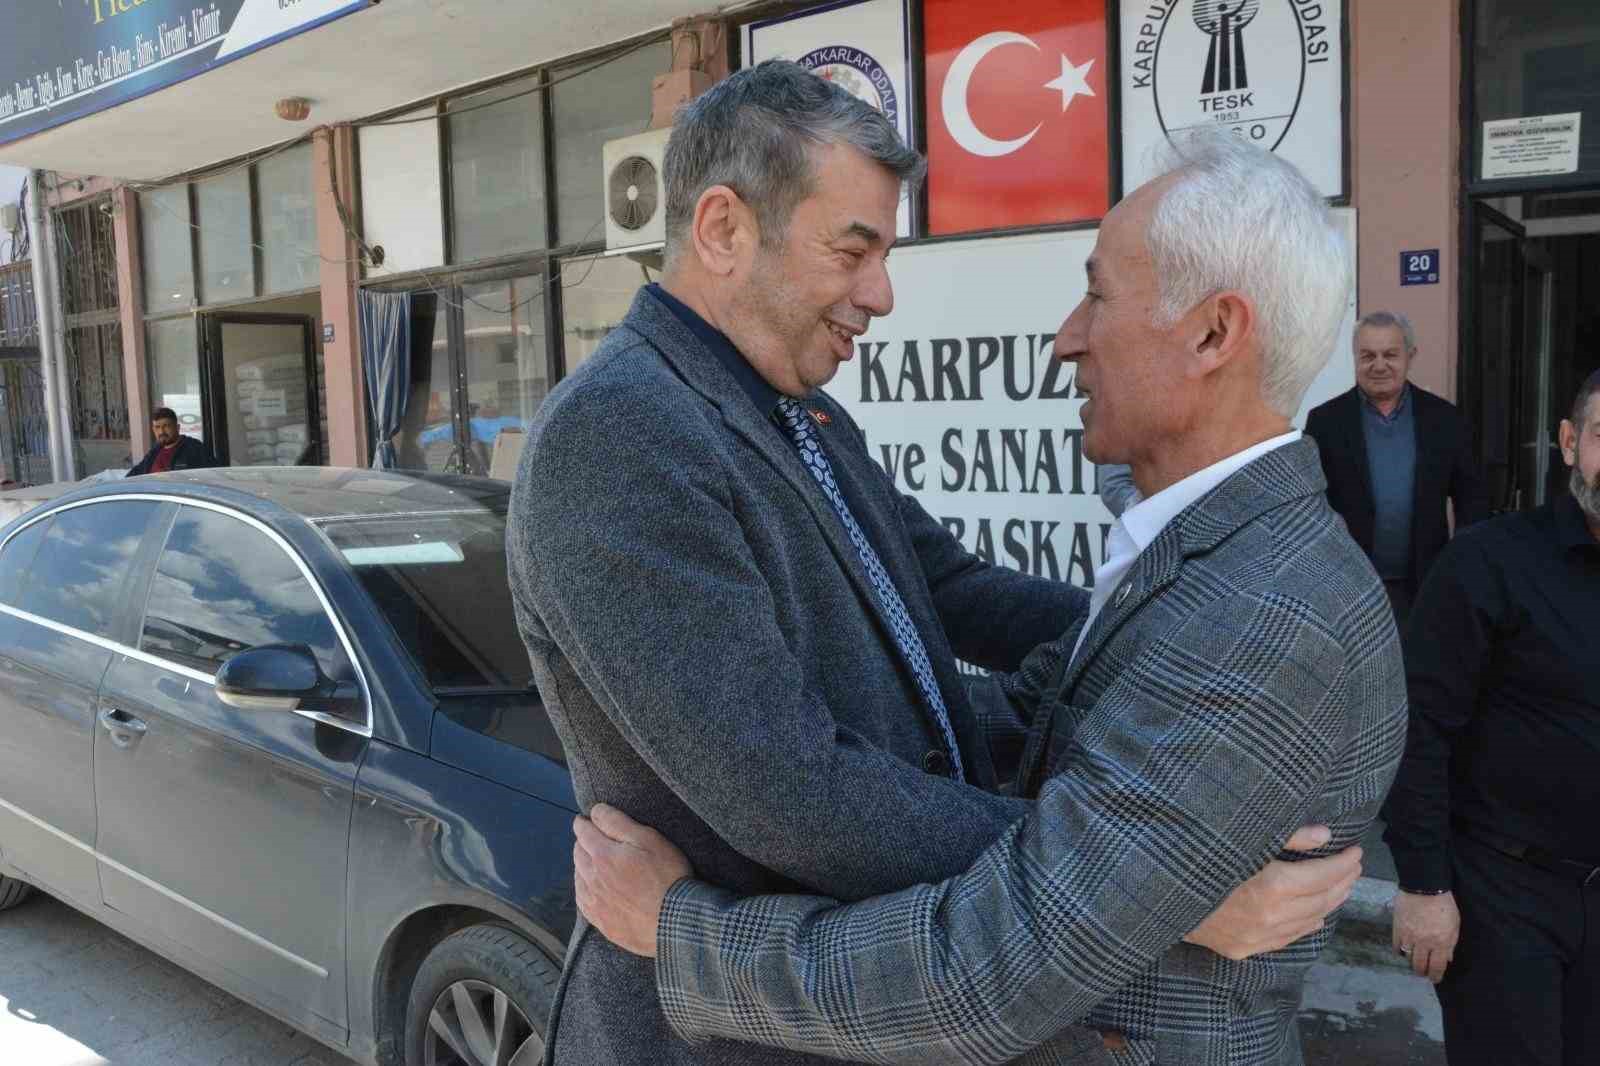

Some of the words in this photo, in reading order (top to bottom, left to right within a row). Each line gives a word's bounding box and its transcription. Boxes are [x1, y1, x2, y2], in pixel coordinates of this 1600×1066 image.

[158, 16, 188, 58] Kiremit
[192, 3, 221, 45] Kömür
[1199, 93, 1254, 113] TESK
[1409, 255, 1430, 272] 20
[857, 333, 1087, 403] KARPUZ
[879, 442, 926, 492] ve
[940, 428, 1101, 494] SANAT
